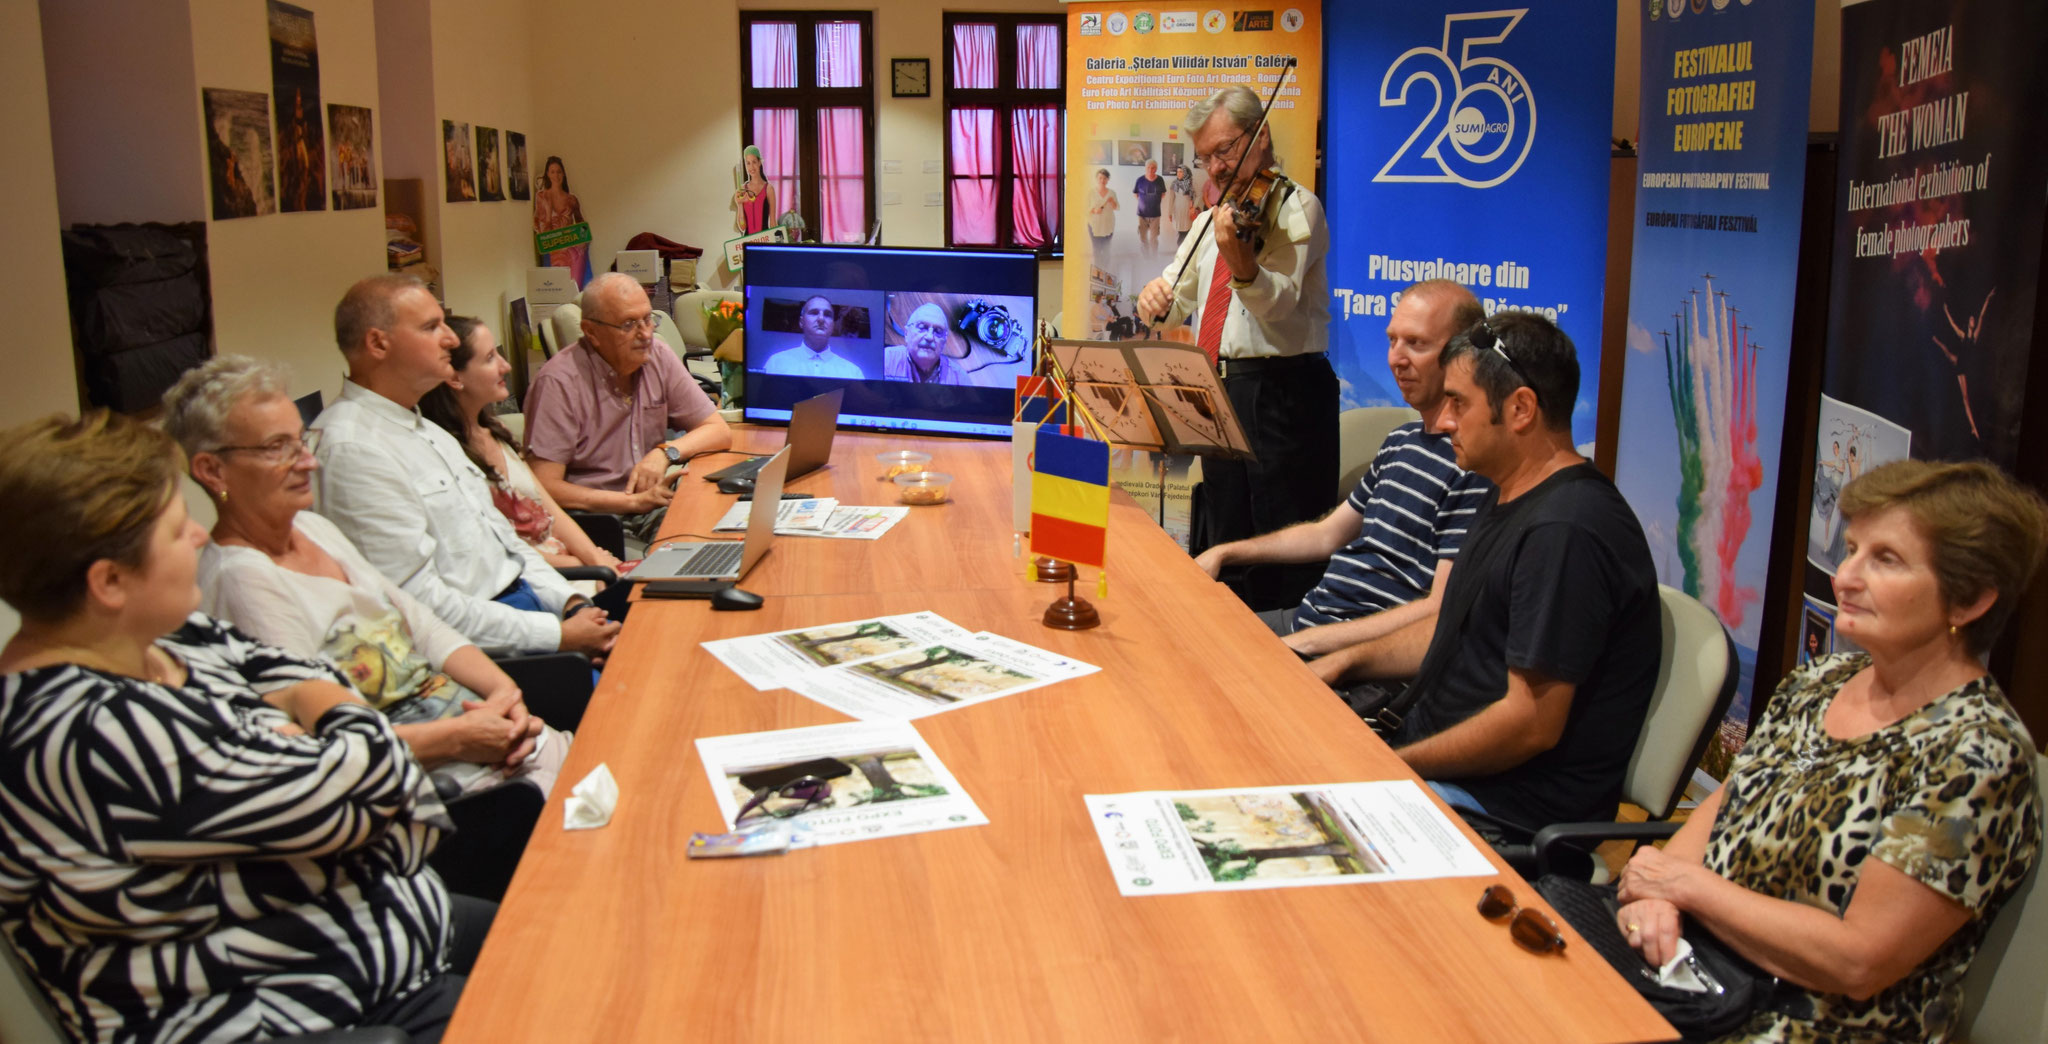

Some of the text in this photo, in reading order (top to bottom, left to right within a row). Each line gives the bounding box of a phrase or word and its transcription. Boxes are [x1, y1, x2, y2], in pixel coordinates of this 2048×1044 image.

[1248, 20, 1269, 28] ARTE
[1086, 57, 1126, 70] Galeria
[1172, 55, 1210, 69] Vilidár
[1673, 40, 1753, 78] FESTIVALUL
[1899, 24, 1954, 88] FEMEIA
[1086, 75, 1114, 84] Centru
[1167, 74, 1184, 84] Euro
[1186, 74, 1205, 83] Foto
[1206, 74, 1219, 83] Art
[1221, 73, 1251, 83] Oradea
[1257, 73, 1297, 83] Roma
[1486, 67, 1524, 104] ANI
[1081, 87, 1100, 97] Euro
[1101, 87, 1118, 96] Foto
[1119, 87, 1132, 96] Art
[1262, 86, 1301, 96] Roánia
[1371, 8, 1537, 189] 25
[1667, 80, 1756, 116] FOTOGRAFIEI
[1087, 100, 1105, 110] Euro
[1106, 100, 1130, 109] Photo
[1131, 100, 1144, 109] Art
[1145, 99, 1186, 109] Exhibition
[1261, 99, 1295, 109] oania
[1878, 91, 1969, 159] THE WOMAN
[1673, 120, 1744, 152] EUROPENE
[1642, 172, 1770, 190] EUROPEAN PHOTOGRAPHY FESTIVAL
[1847, 152, 1992, 212] International exhibition of
[1718, 214, 1758, 233] FESZTIVÁL
[543, 233, 580, 250] SUPERIA
[1855, 213, 1971, 260] female photographers
[1368, 254, 1530, 289] Plusvaloare din
[1164, 492, 1191, 501] Fejedelm
